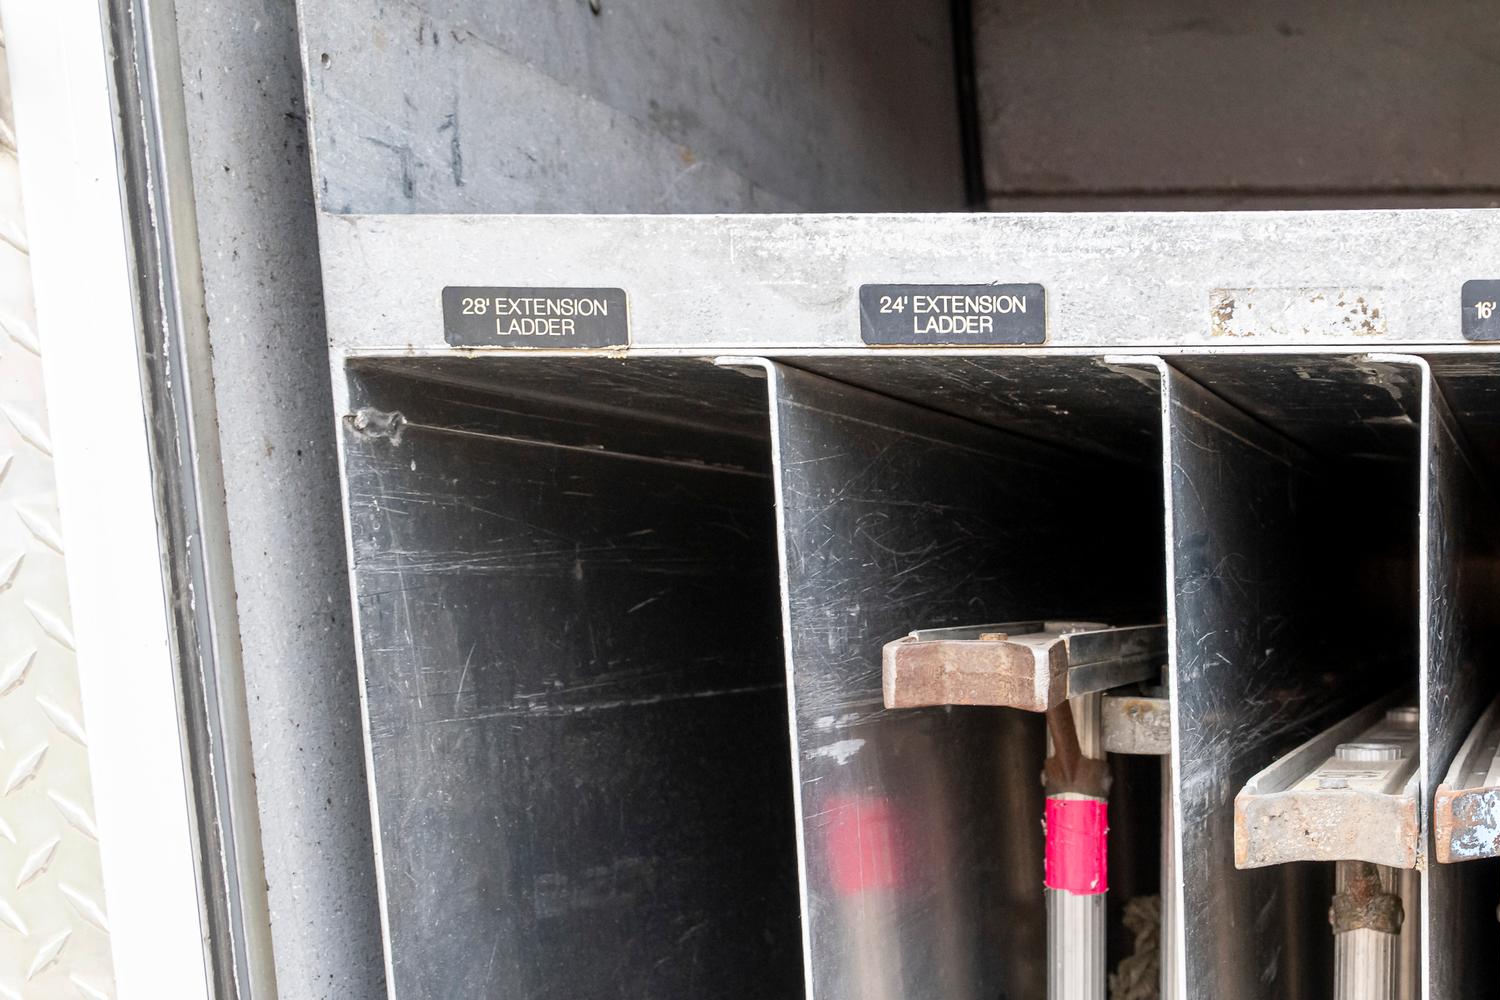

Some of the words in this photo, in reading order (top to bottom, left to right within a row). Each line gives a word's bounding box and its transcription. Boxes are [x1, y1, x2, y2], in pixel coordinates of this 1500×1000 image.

[462, 298, 490, 316] 28'
[495, 298, 608, 317] EXTENSION
[879, 296, 909, 314] 24'
[913, 296, 1027, 314] EXTENSION
[1474, 300, 1497, 319] 16'
[496, 317, 575, 336] LADDER
[913, 315, 993, 334] LADDER
